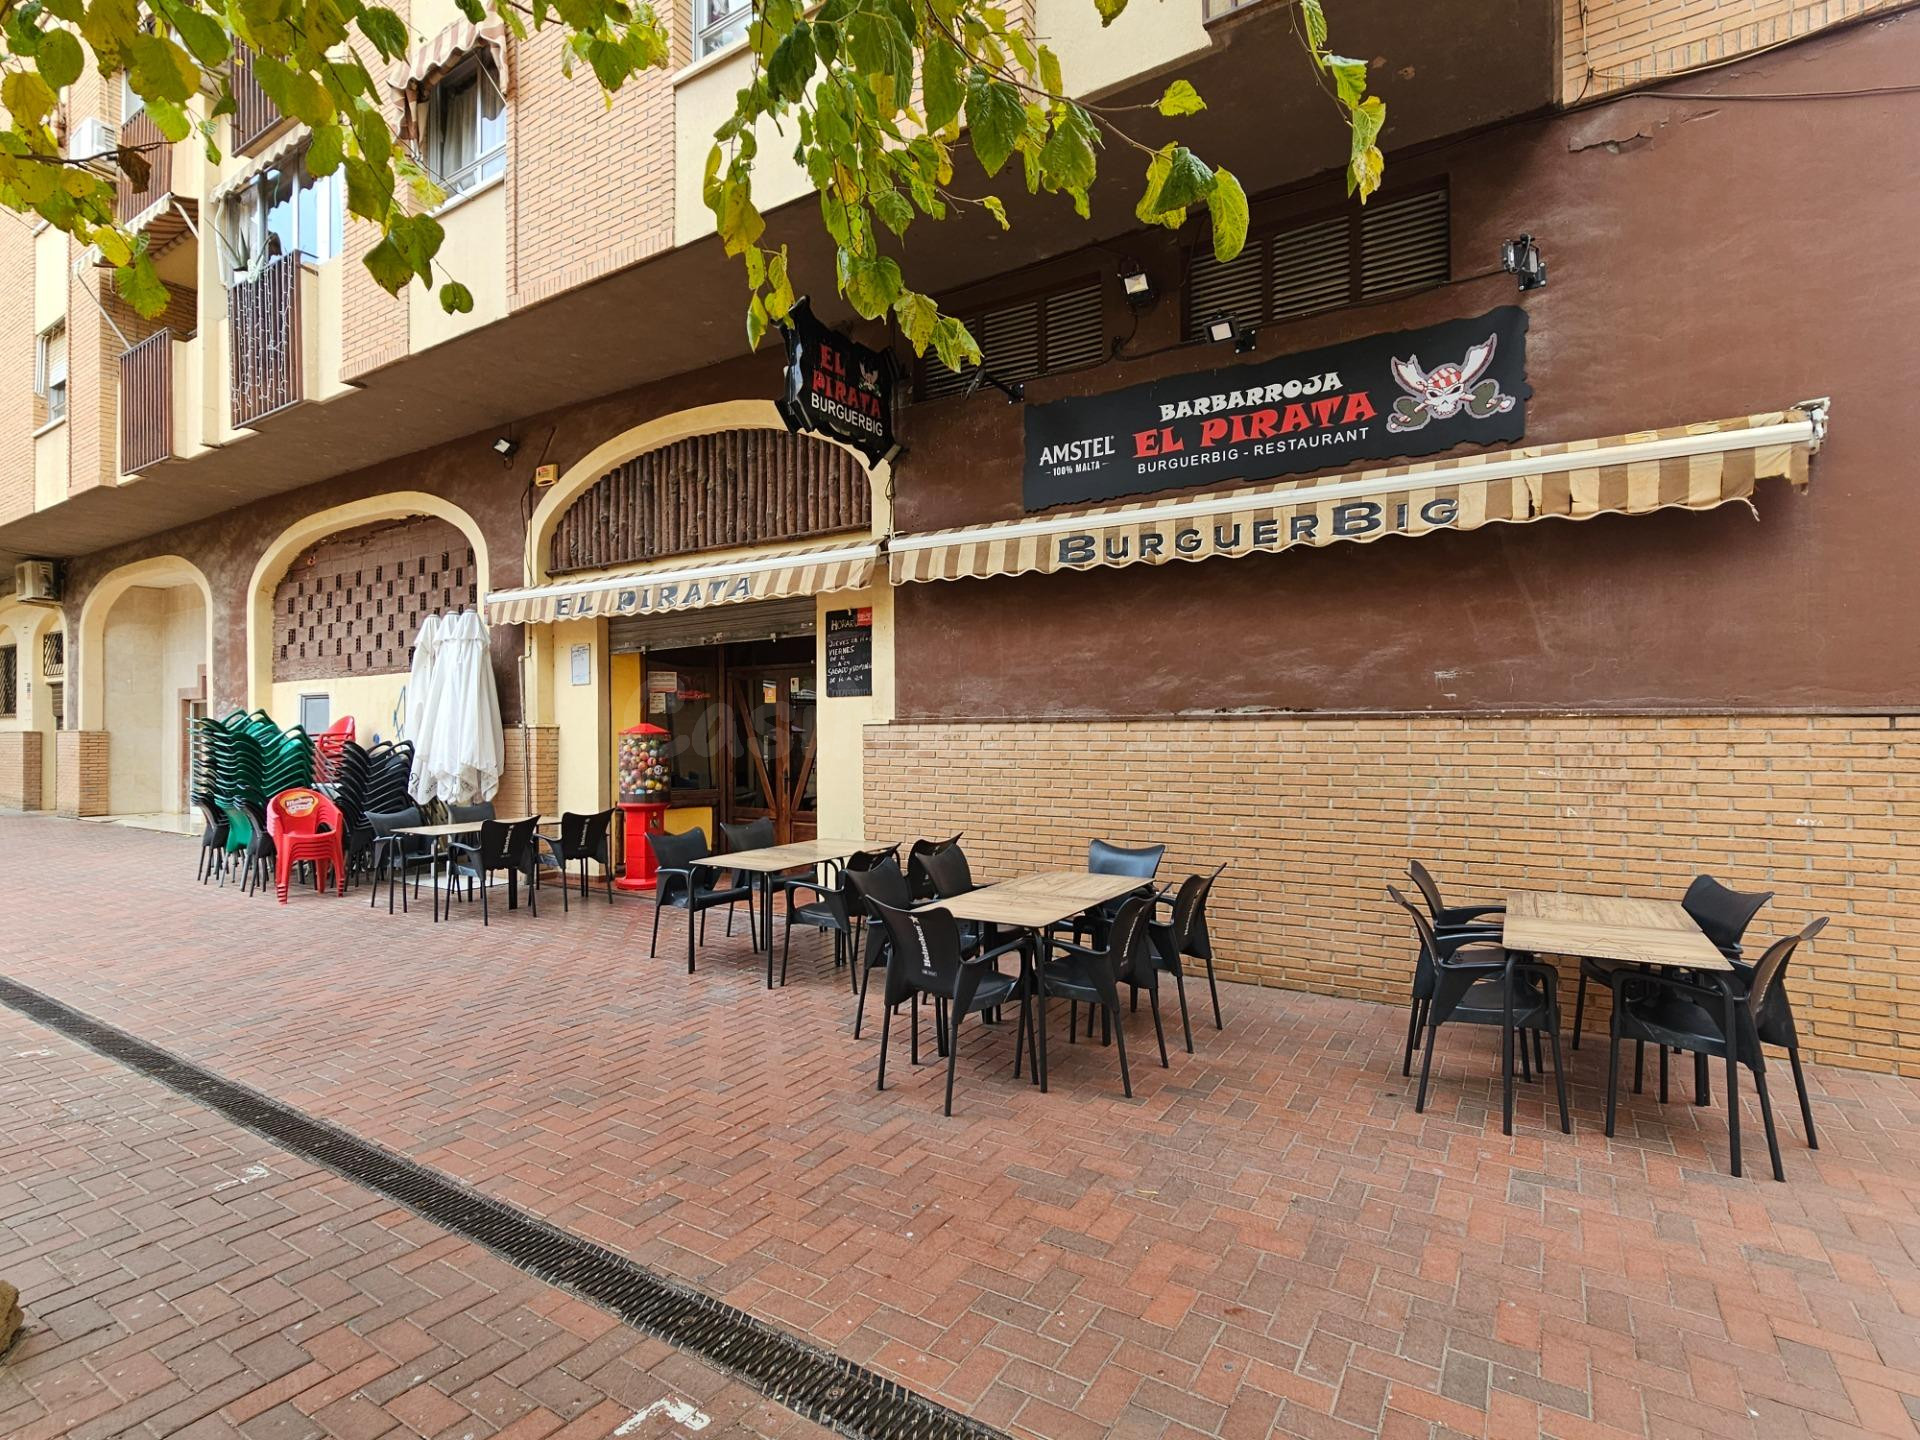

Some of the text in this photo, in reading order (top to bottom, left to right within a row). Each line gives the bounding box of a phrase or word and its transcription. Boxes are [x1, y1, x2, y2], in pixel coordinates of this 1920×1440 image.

[820, 344, 846, 378] EL
[811, 392, 883, 437] BURGUERBIG
[812, 370, 881, 418] PIRATA
[1159, 371, 1344, 422] BARBARROJA
[1132, 391, 1379, 459] EL PIRATA
[1053, 460, 1100, 477] 100% MALTA
[1137, 448, 1239, 475] BURGUERBIG
[1254, 427, 1370, 456] RESTAURANT
[556, 576, 751, 616] EL PIRATA
[829, 646, 855, 656] VIERNES
[915, 924, 932, 968] Heineken
